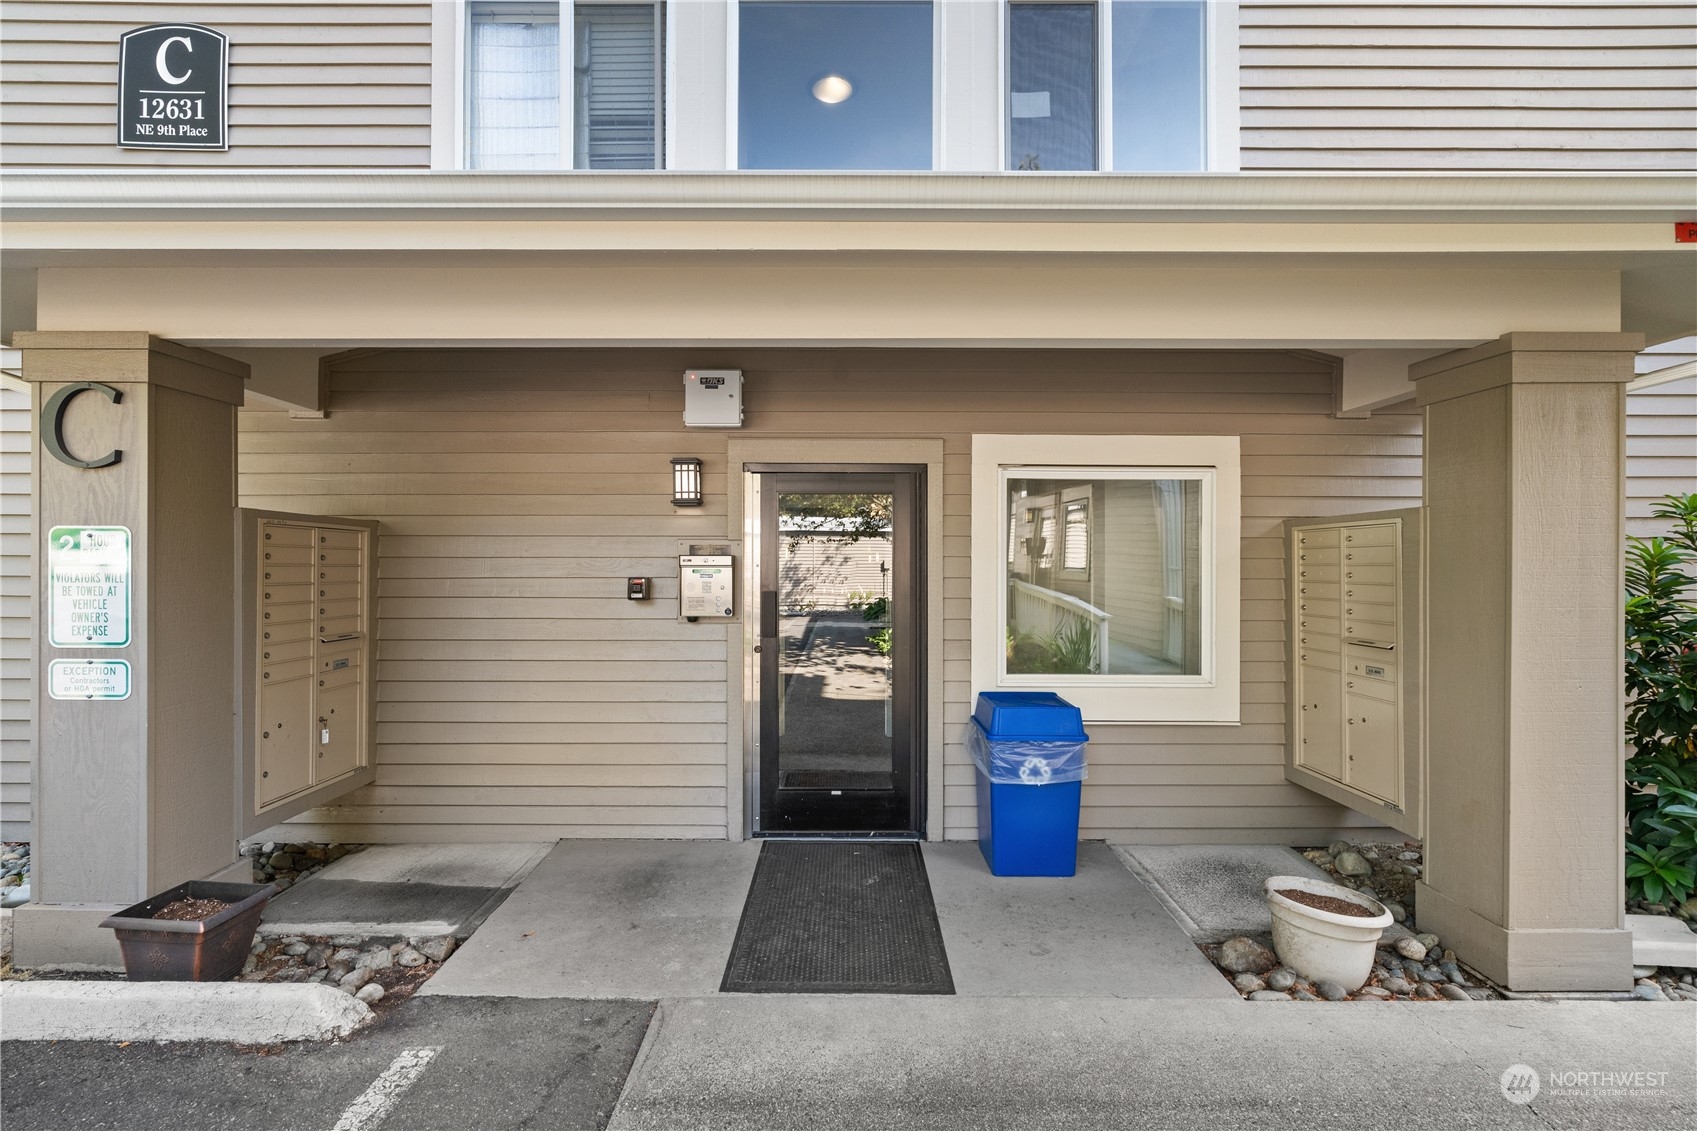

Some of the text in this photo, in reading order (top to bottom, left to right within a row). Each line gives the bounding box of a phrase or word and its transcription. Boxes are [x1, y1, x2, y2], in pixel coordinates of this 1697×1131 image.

[156, 36, 193, 85] C
[139, 98, 205, 120] 12631
[135, 123, 208, 137] NE 9th Place
[41, 381, 124, 469] C
[59, 535, 75, 561] 2
[56, 572, 124, 584] VIOLATORS WILL
[62, 585, 118, 597] BE TOWED AT
[72, 598, 108, 610] VEHICLE
[71, 611, 109, 623] OWNER'S
[71, 625, 109, 637] EXPENSE
[63, 666, 117, 676] EXCEPTION
[69, 677, 110, 685] Contractors
[92, 685, 116, 694] permit
